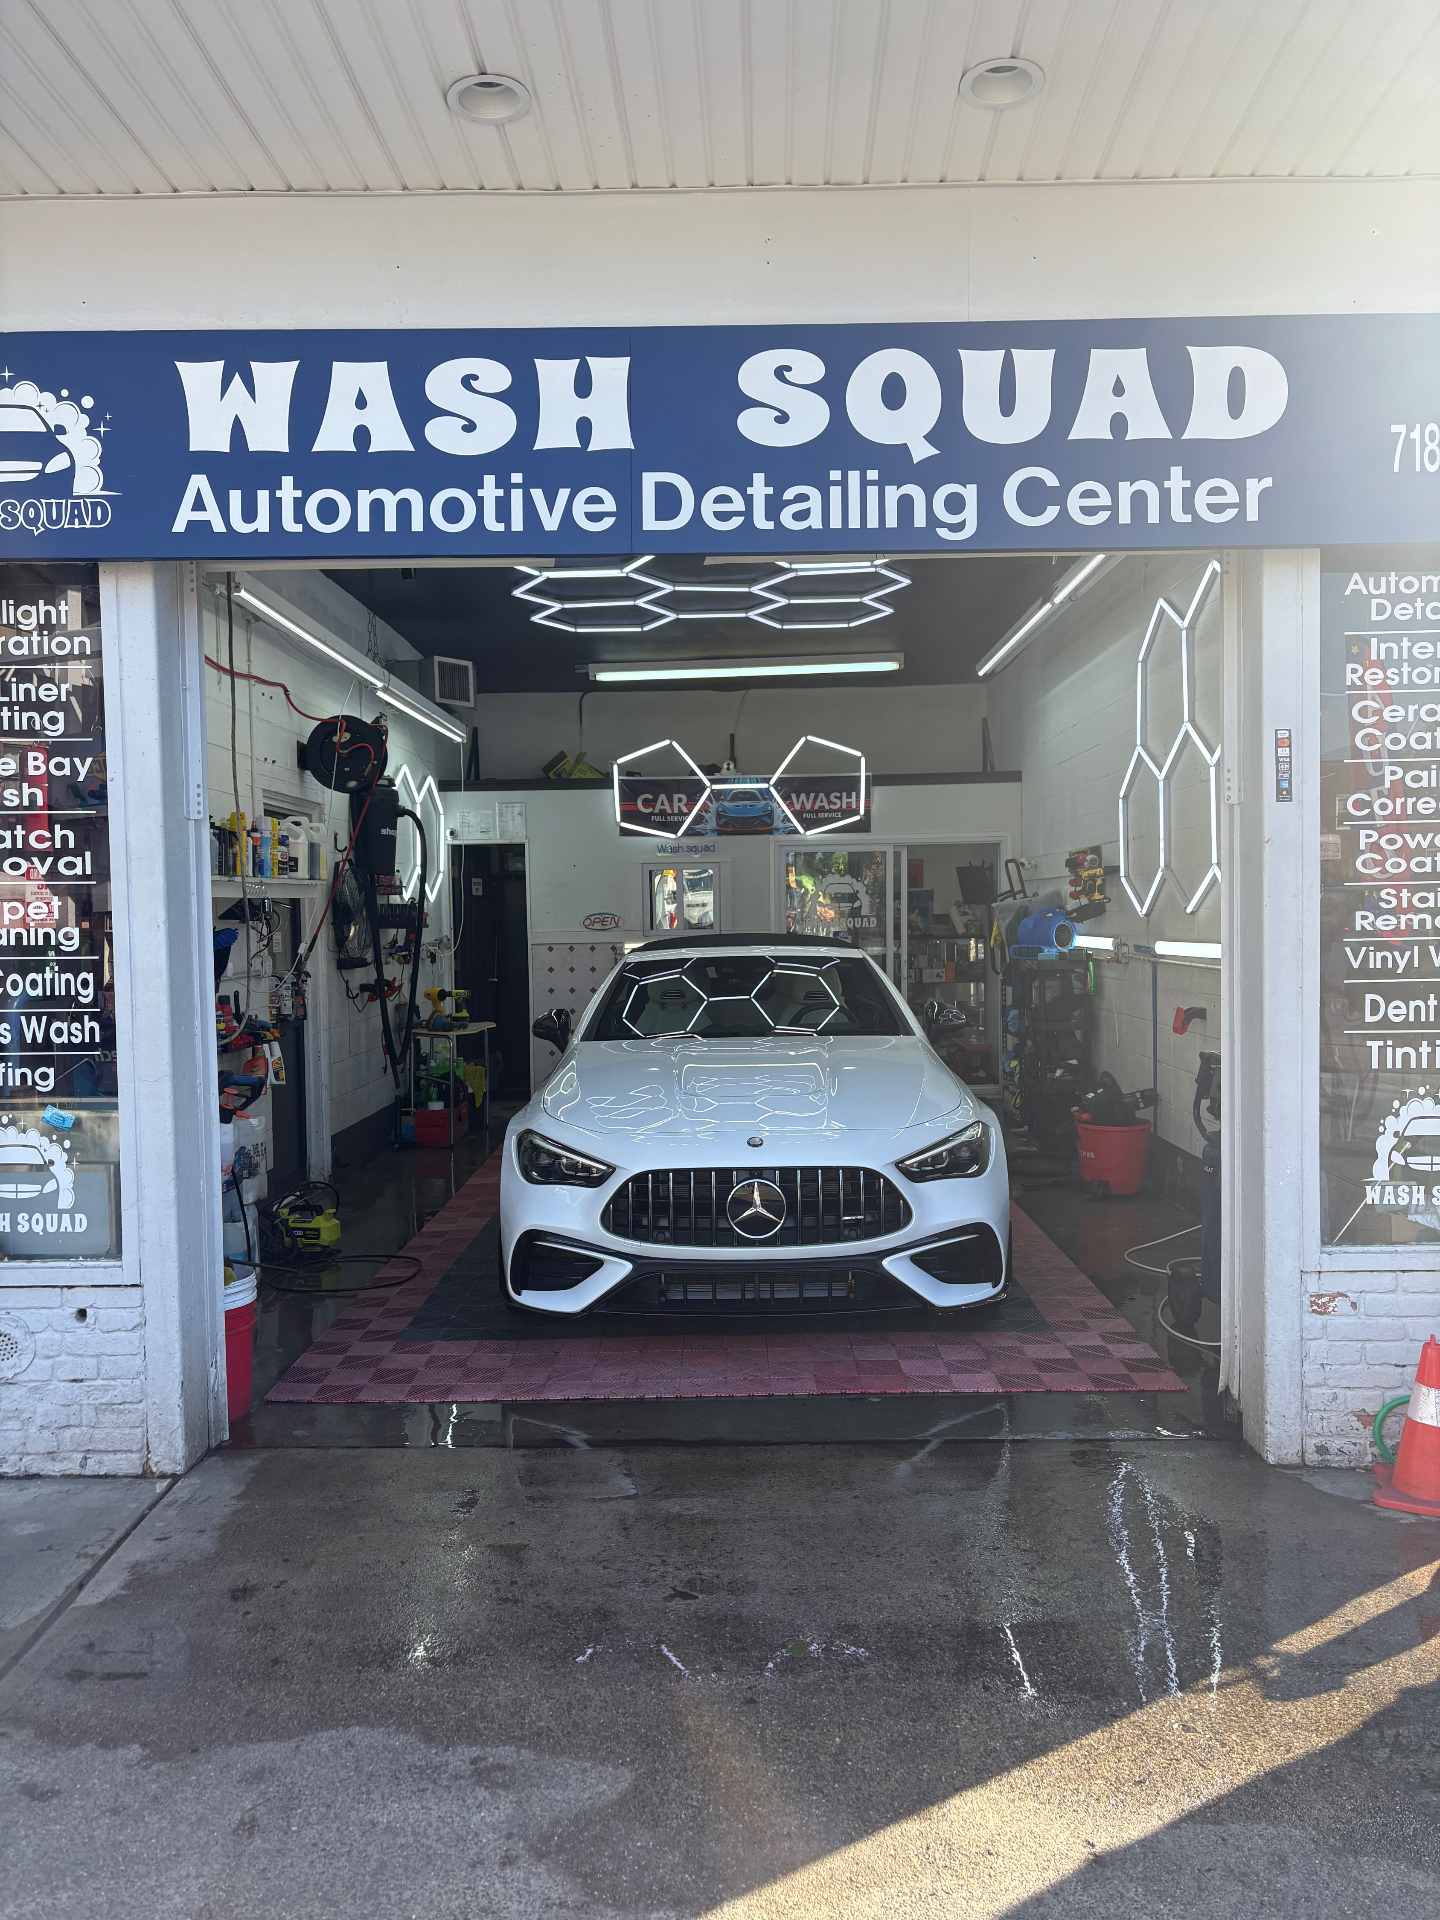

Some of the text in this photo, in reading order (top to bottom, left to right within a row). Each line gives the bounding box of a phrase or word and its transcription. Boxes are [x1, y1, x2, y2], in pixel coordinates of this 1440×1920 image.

[174, 346, 1289, 464] WASH SQUAD
[171, 465, 1273, 541] Automotive Detailing Center
[0, 497, 112, 537] SQUAD
[1, 705, 65, 737] ting
[27, 751, 94, 782] Bay
[3, 782, 44, 807] sh
[637, 793, 689, 814] CAR
[790, 791, 856, 810] WASH
[656, 842, 716, 855] Wash squad
[2, 851, 92, 876] oval
[3, 895, 62, 925] pet
[582, 916, 620, 927] OPEN
[839, 917, 877, 929] SQUAD
[1344, 945, 1419, 974] Vinyl
[1364, 993, 1437, 1023] Dent
[20, 1015, 100, 1044] Wash
[1365, 1185, 1425, 1206] WASH
[17, 1213, 88, 1235] SQUAD
